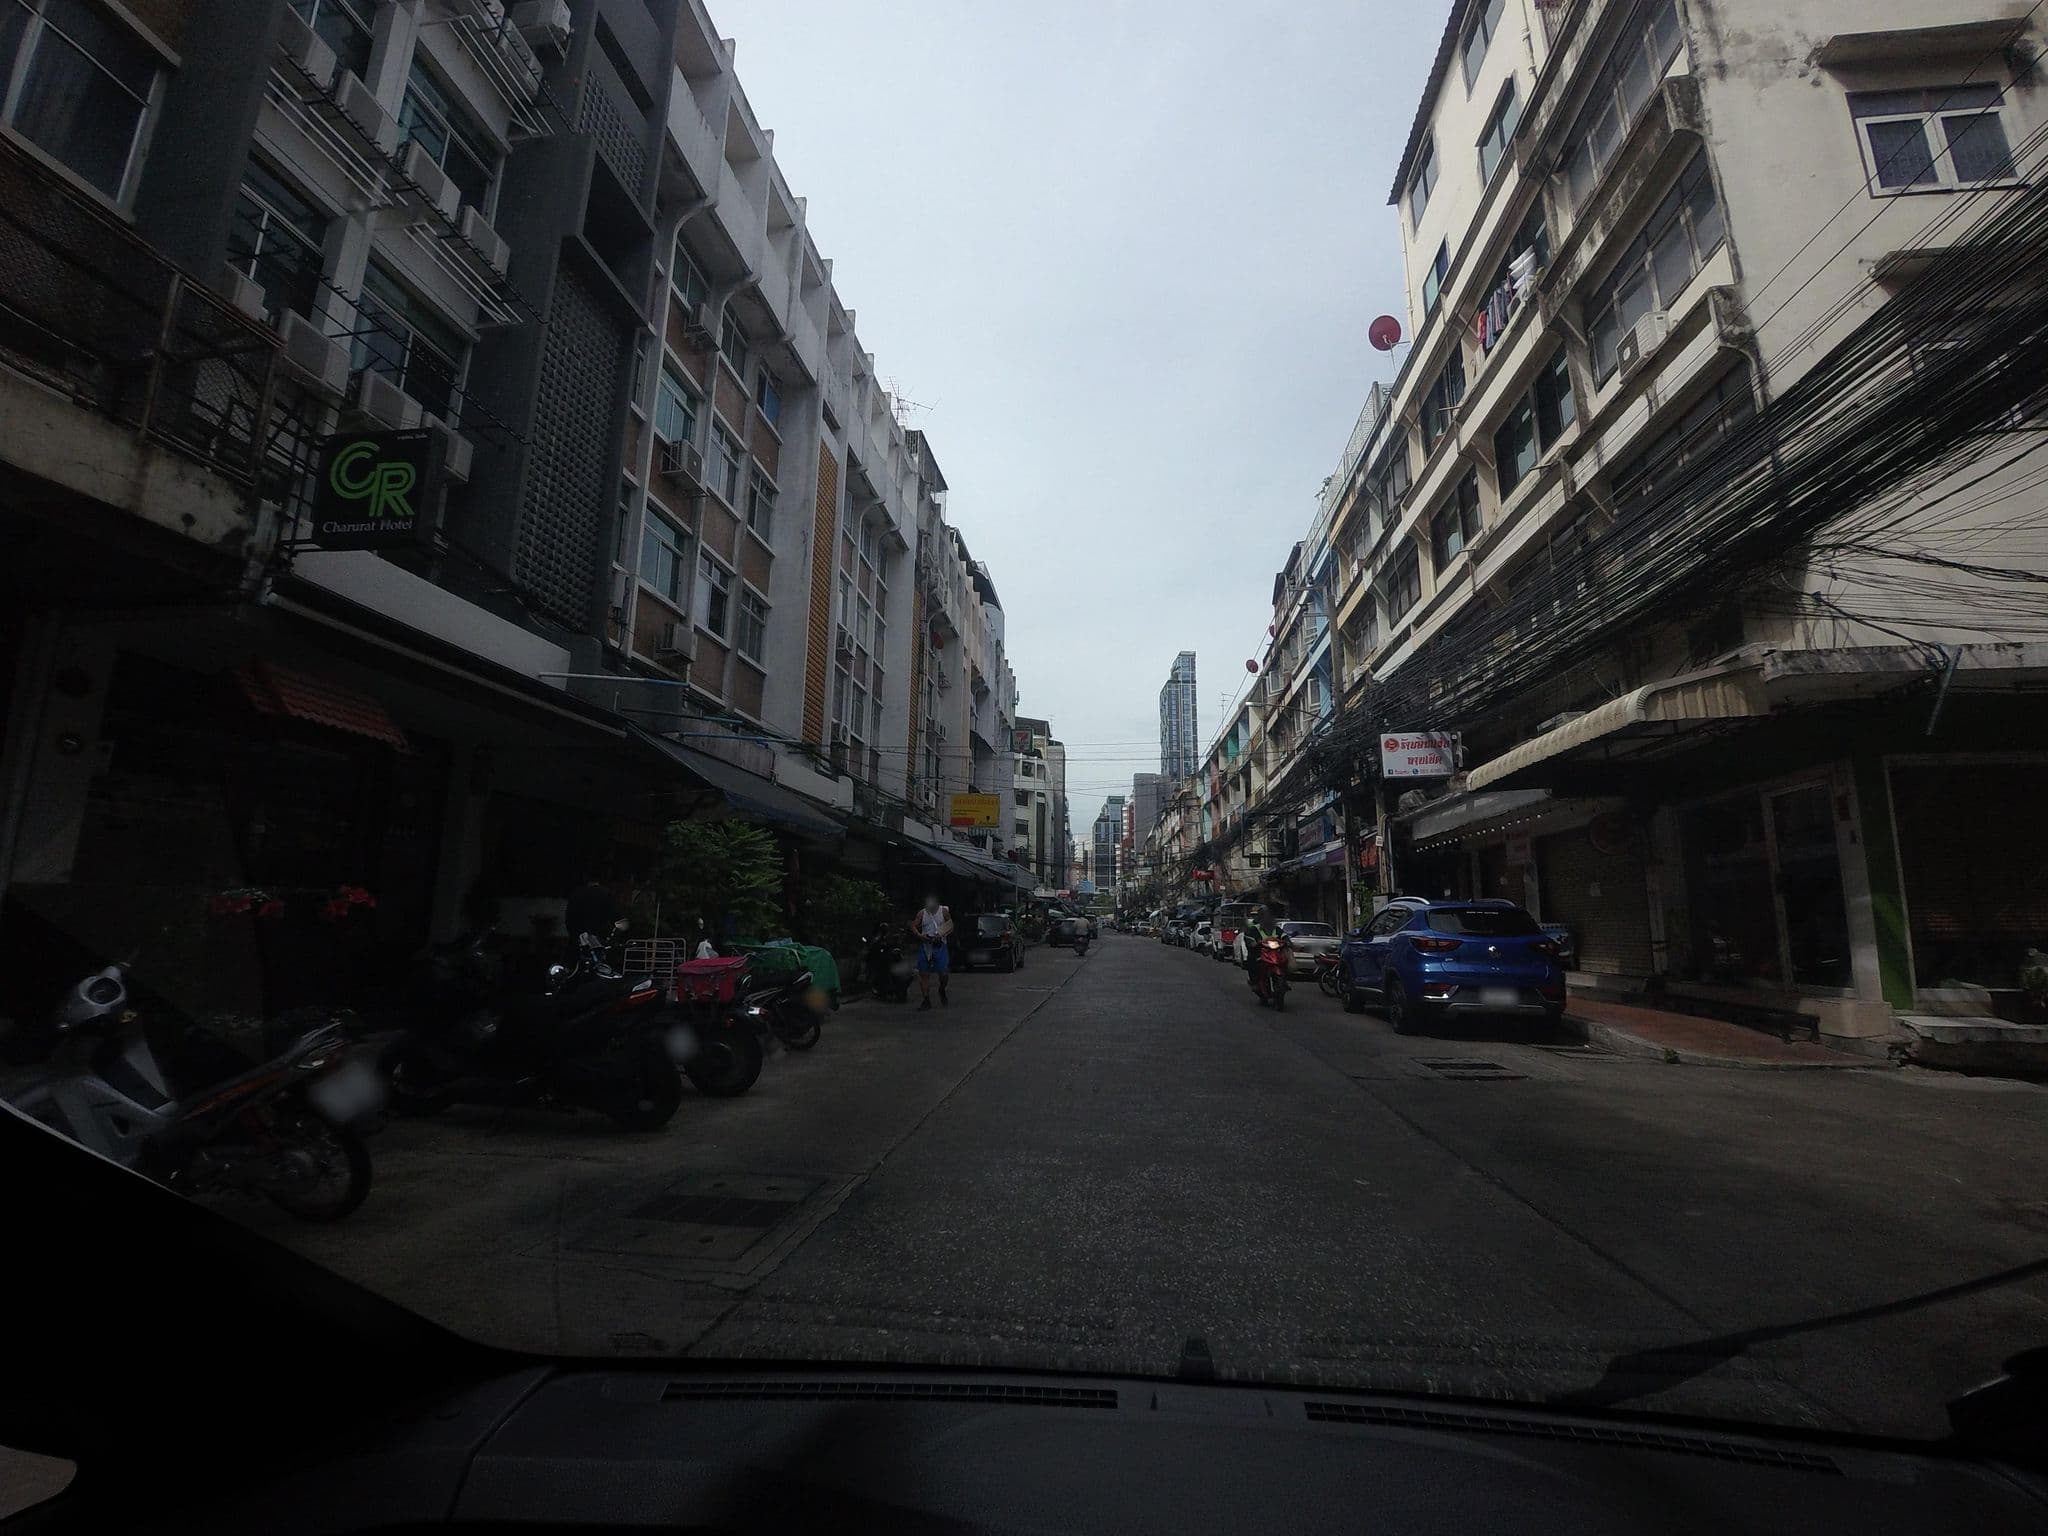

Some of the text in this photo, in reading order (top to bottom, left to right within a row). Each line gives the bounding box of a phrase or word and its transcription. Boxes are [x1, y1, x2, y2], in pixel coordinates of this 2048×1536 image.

[330, 441, 416, 517] CR
[322, 518, 414, 534] Charurat Hotel
